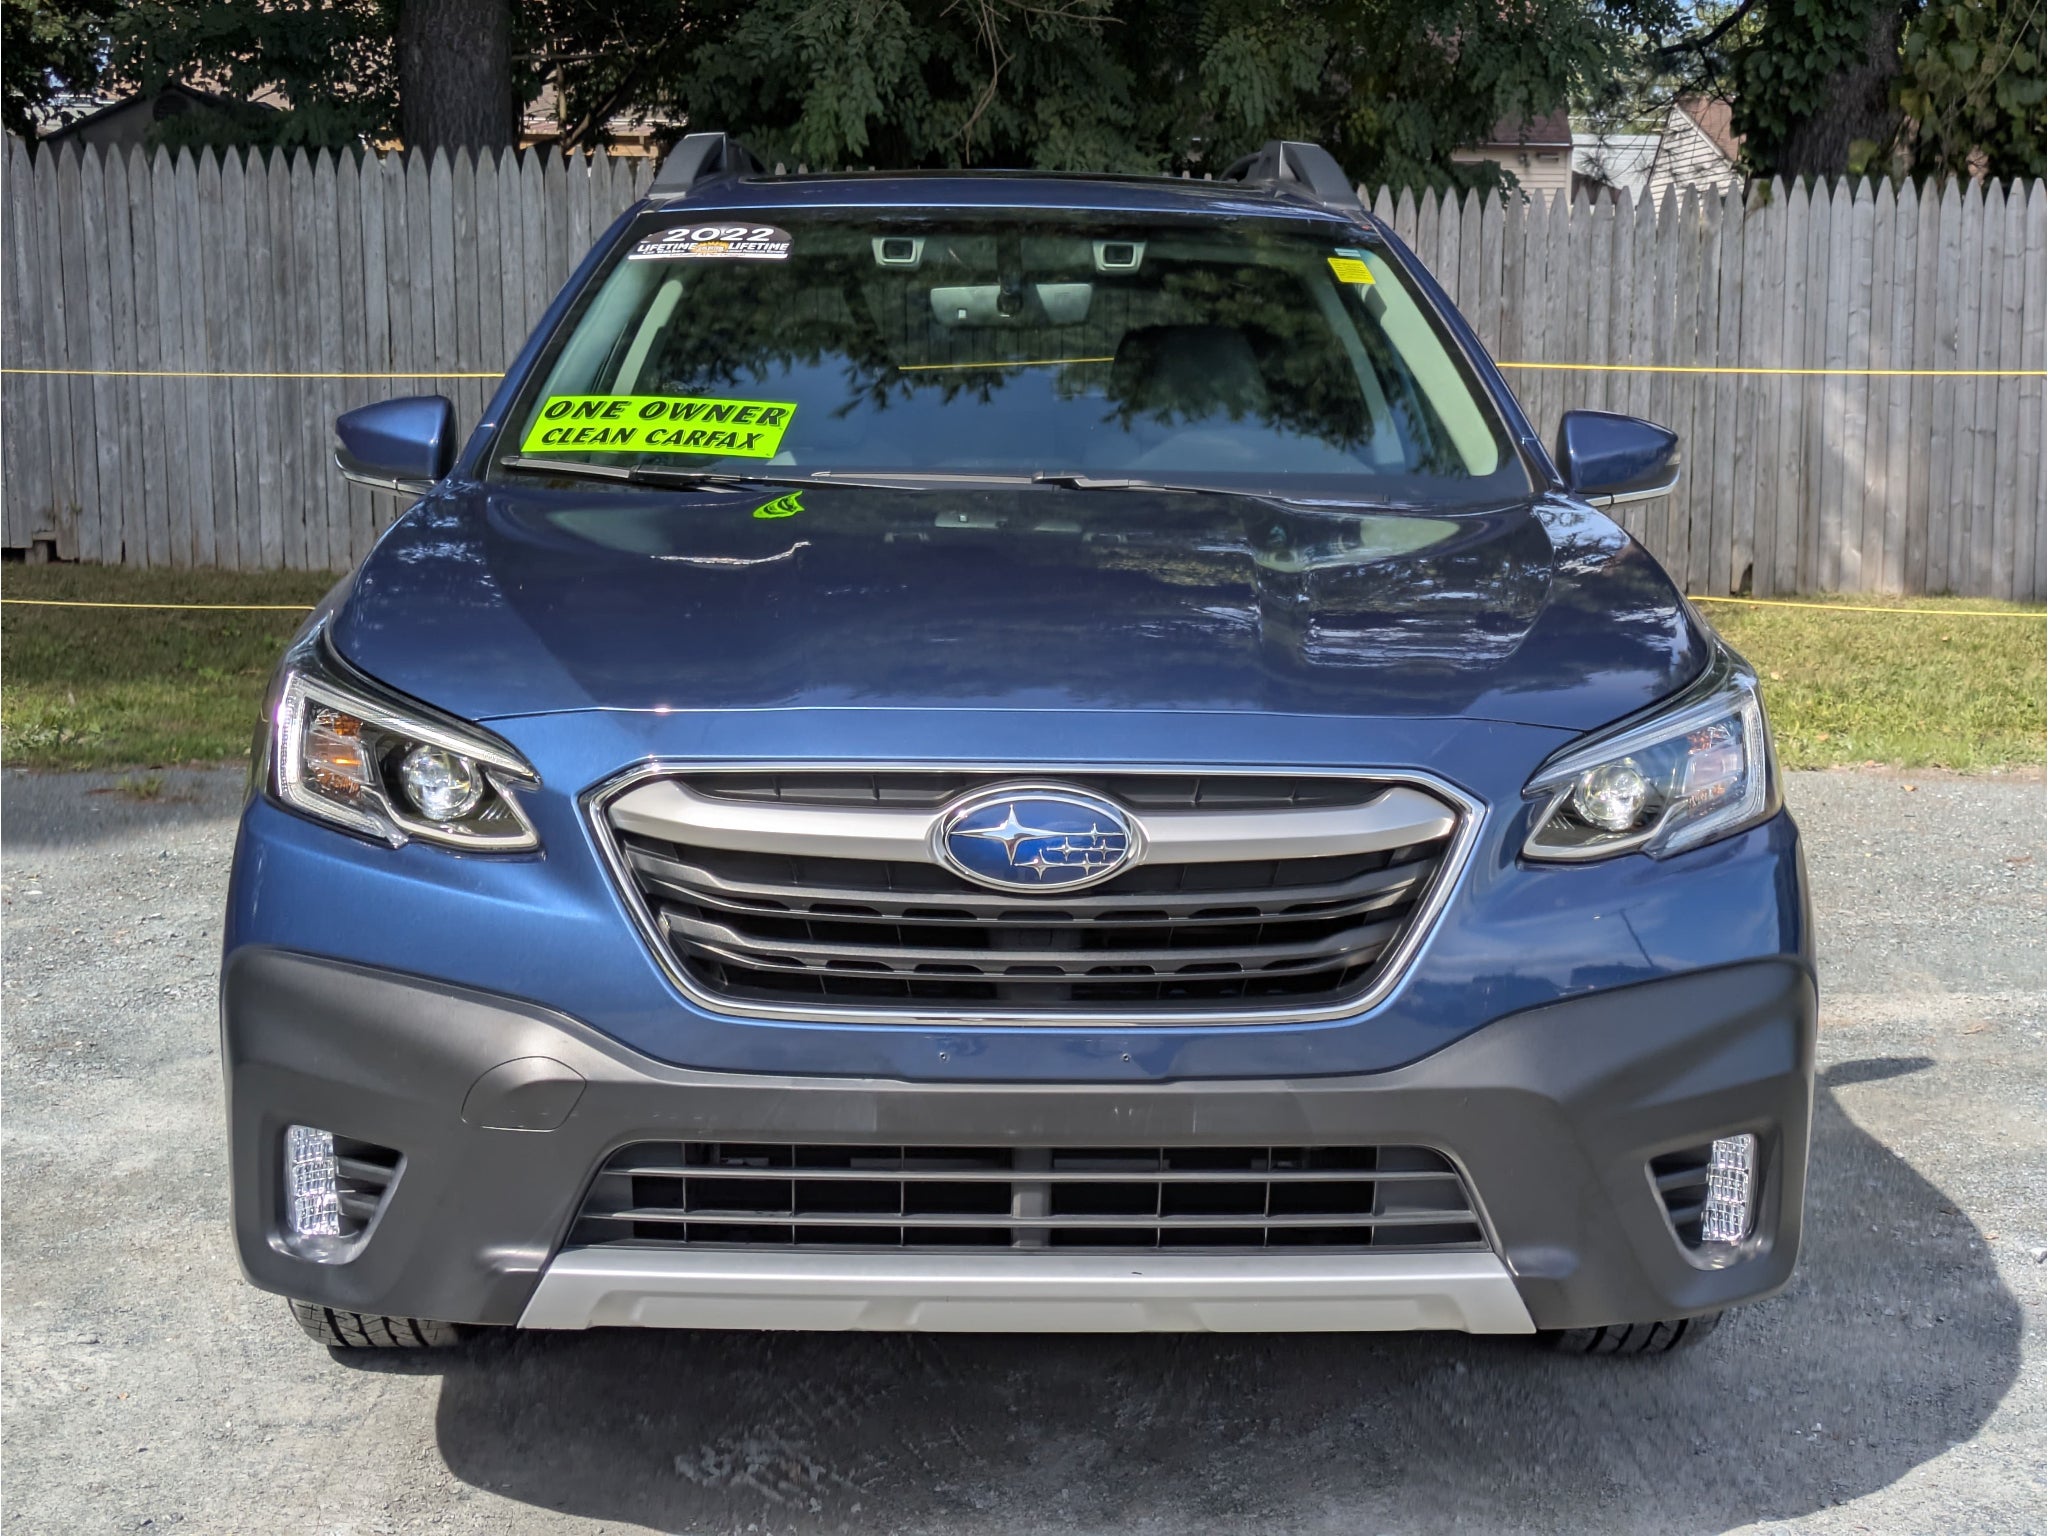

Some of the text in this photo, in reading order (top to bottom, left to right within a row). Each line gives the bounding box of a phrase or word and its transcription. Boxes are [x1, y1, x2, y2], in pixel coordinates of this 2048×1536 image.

[662, 227, 775, 242] 2022
[637, 242, 699, 252] LIFETIME
[727, 242, 790, 251] LIFETIME
[544, 400, 788, 426] ONE OWNER
[541, 427, 763, 450] CLEAN CARFAX
